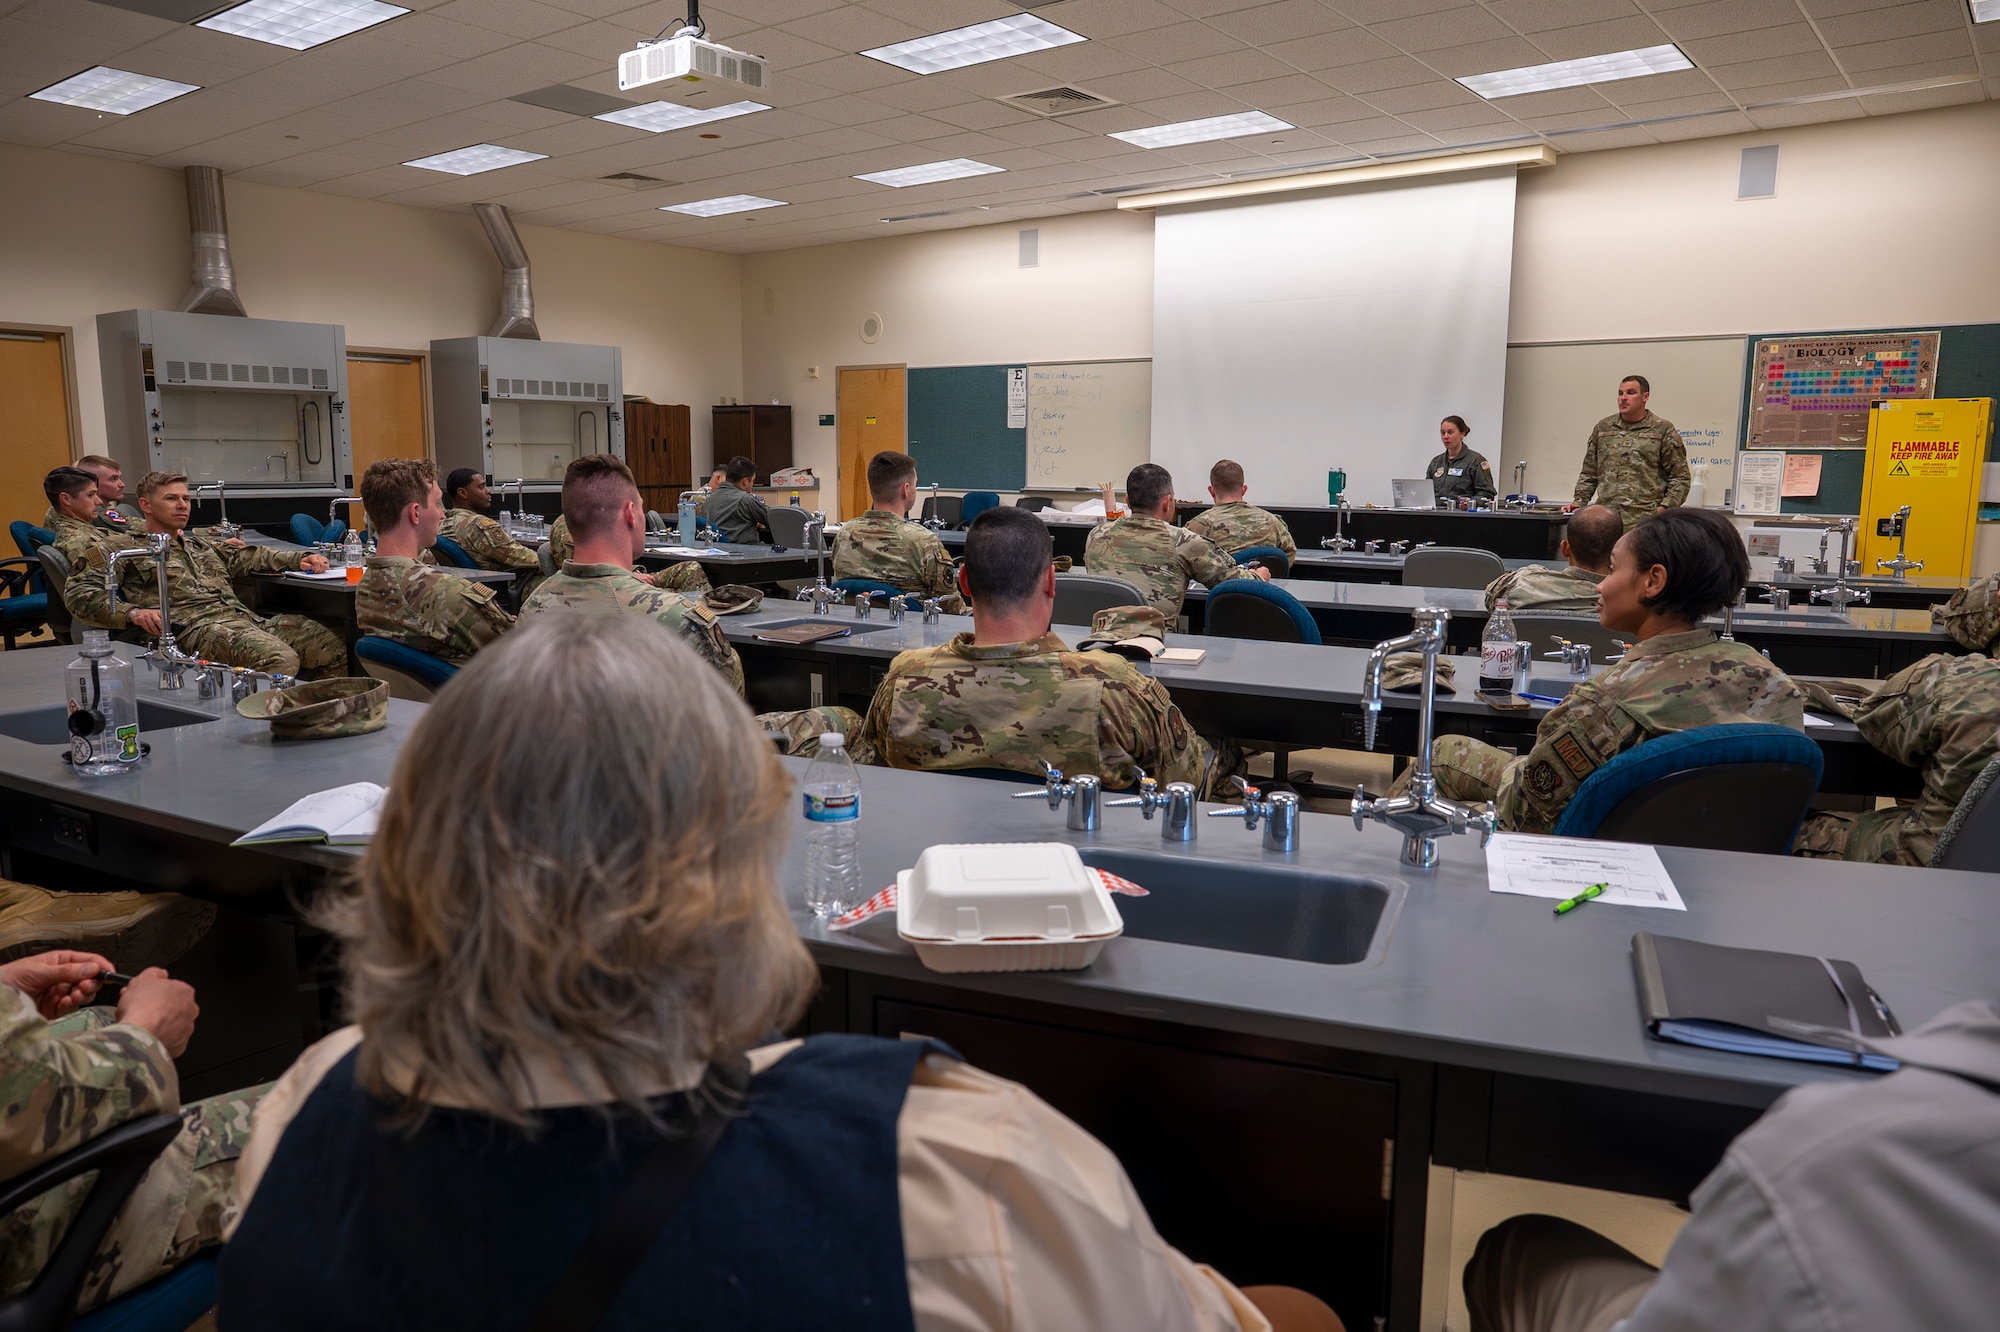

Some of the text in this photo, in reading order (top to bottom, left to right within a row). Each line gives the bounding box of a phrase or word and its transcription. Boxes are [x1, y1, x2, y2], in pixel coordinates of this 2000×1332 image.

[1796, 347, 1856, 358] BIOLOGY
[1014, 369, 1023, 380] E
[1031, 407, 1066, 422] Observe
[1032, 424, 1065, 440] Orient
[1891, 441, 1960, 452] FLAMMABLE
[1890, 452, 1959, 460] KEEP FIRE AWAY
[1033, 456, 1062, 477] Act
[1558, 738, 1588, 773] MED
